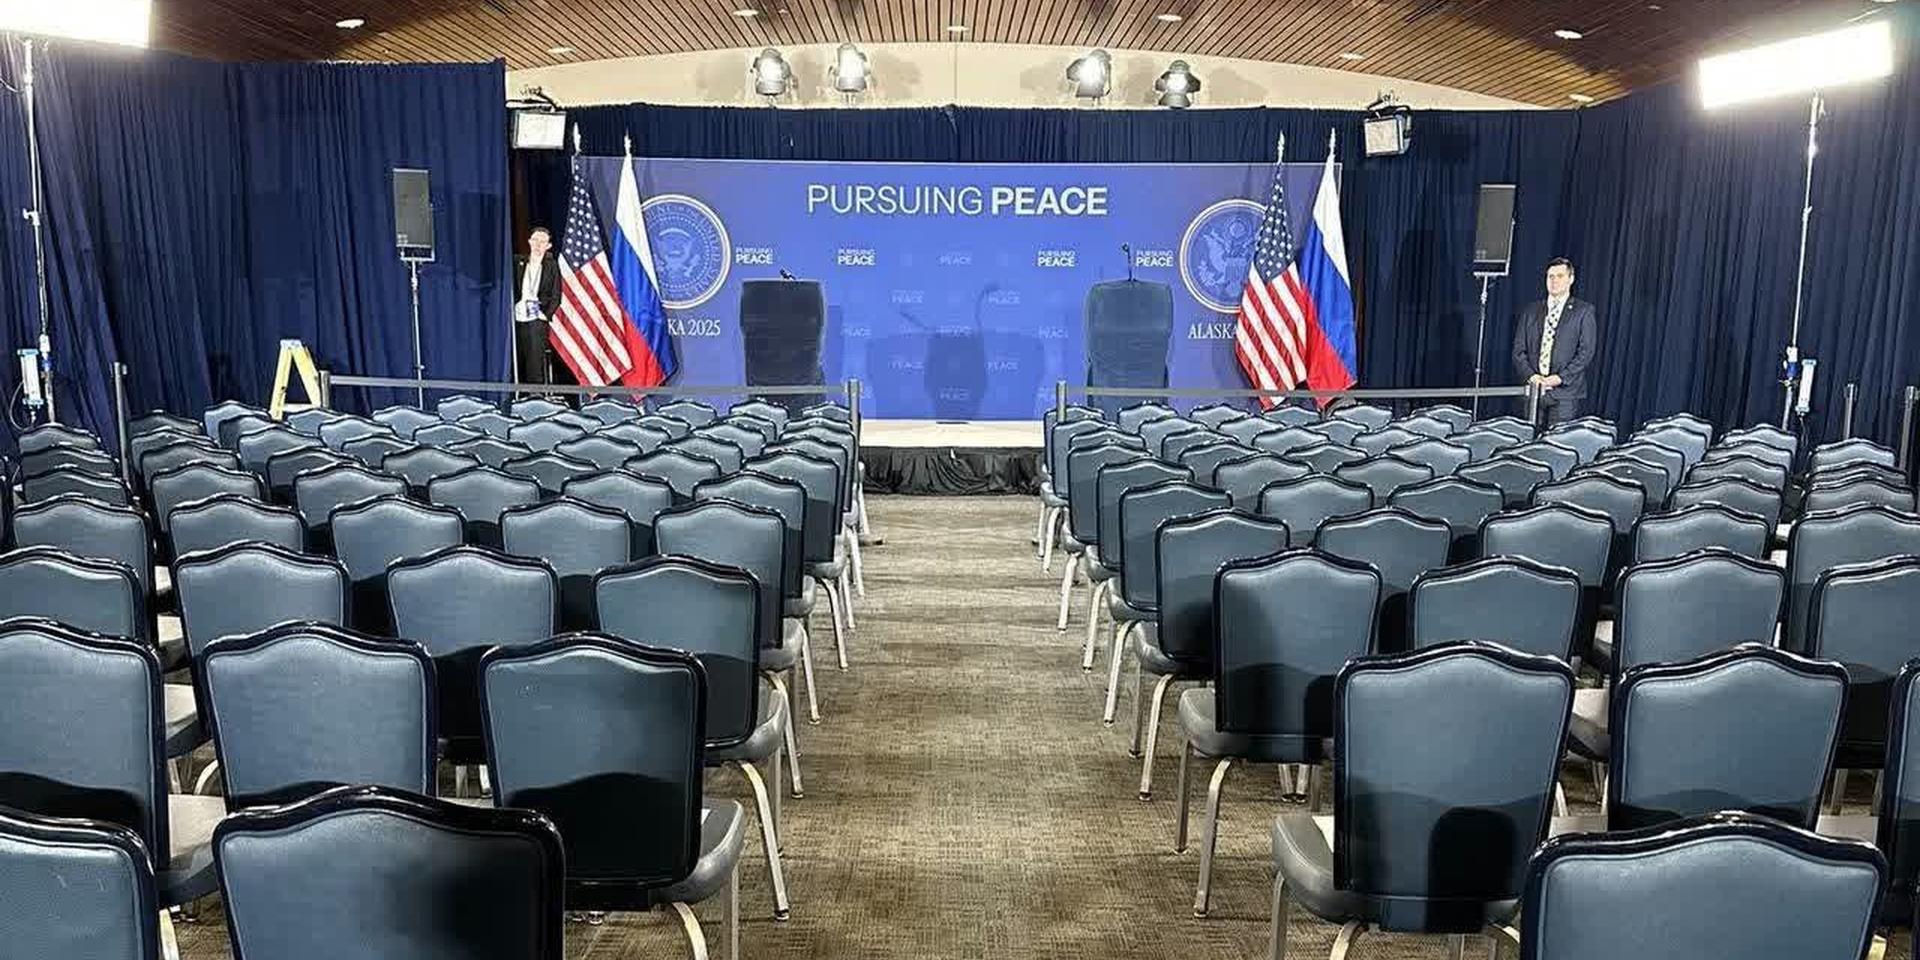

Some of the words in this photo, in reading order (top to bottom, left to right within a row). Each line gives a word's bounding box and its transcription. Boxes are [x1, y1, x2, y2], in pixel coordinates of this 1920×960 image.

[808, 184, 982, 214] PURSUING
[992, 186, 1107, 215] PEACE
[736, 254, 774, 265] PEACE
[838, 255, 876, 266] PEACE
[1038, 257, 1075, 267] PEACE
[1136, 257, 1173, 267] PEACE
[687, 318, 721, 336] 2025
